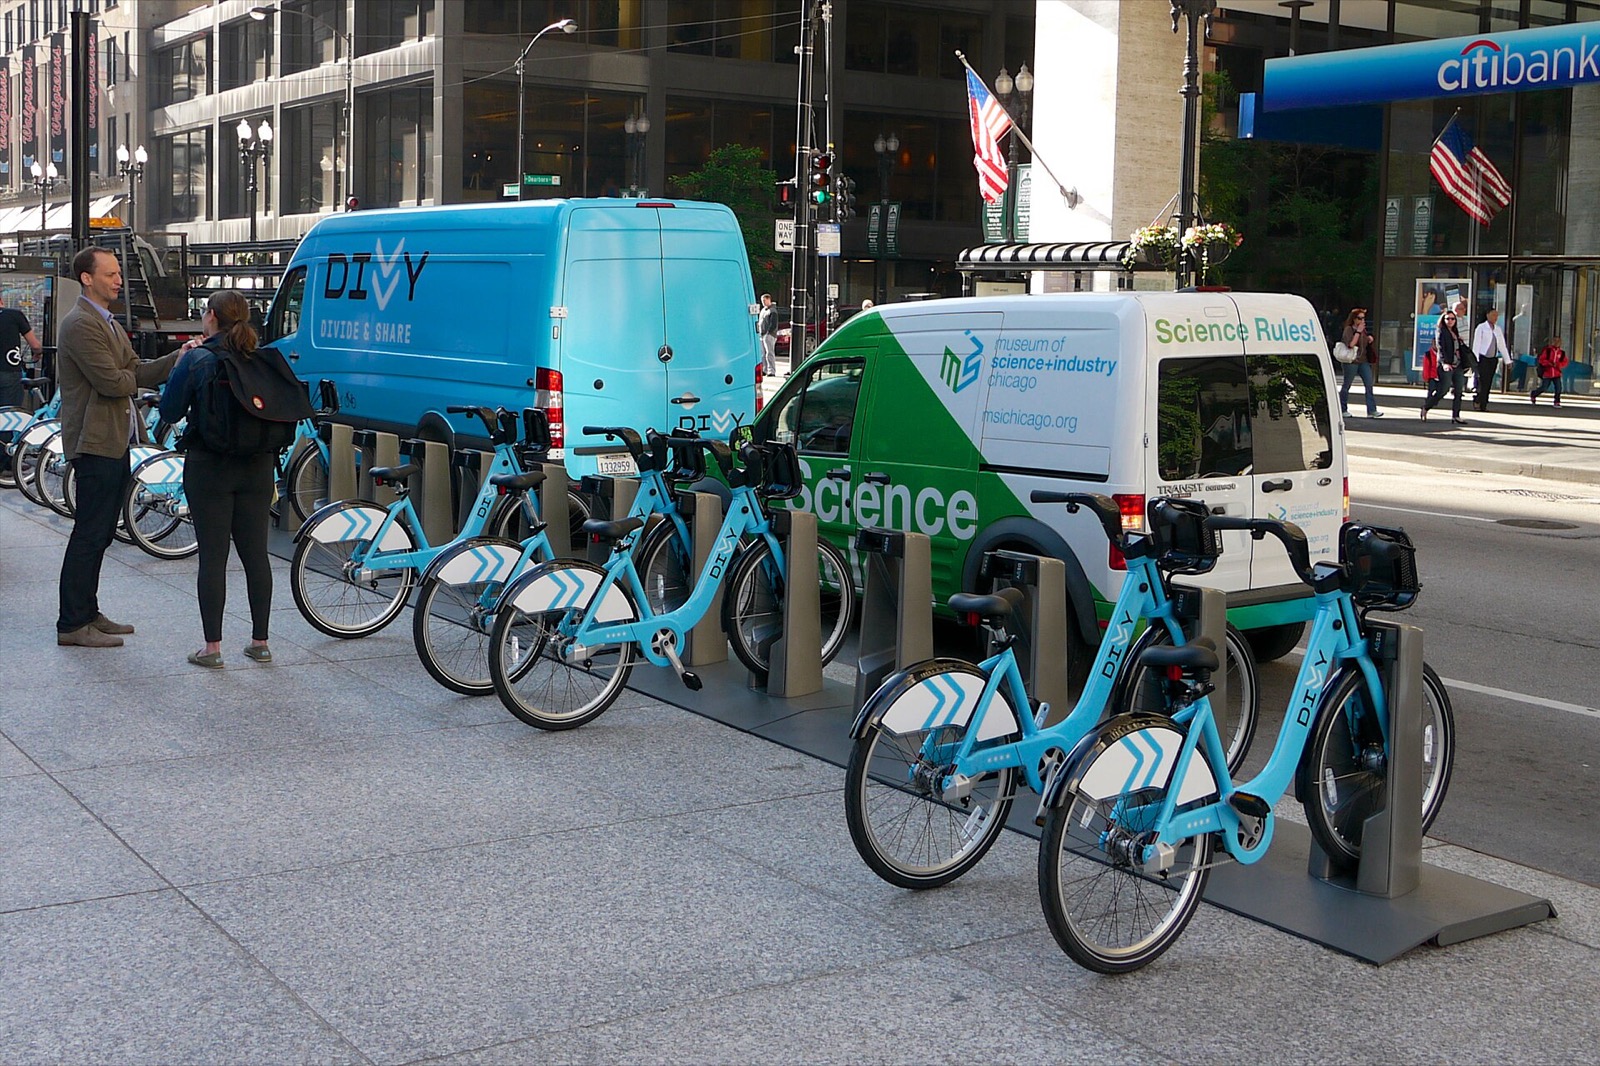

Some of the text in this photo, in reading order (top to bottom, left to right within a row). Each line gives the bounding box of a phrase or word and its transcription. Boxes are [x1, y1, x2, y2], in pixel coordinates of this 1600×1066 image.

[1437, 35, 1600, 91] citibank
[23, 56, 36, 144] Walgreens
[52, 44, 64, 139] Walgreens
[778, 222, 793, 231] ONE
[778, 231, 793, 239] WAY
[321, 319, 412, 344] DIVIDE & SHARE
[1155, 317, 1318, 344] Science Rules!
[995, 336, 1067, 353] museum of
[991, 353, 1118, 377] science+industry
[987, 371, 1038, 393] chicago
[982, 408, 1078, 434] msichicago.org
[785, 458, 979, 541] Science
[1157, 482, 1204, 495] TRANSIT
